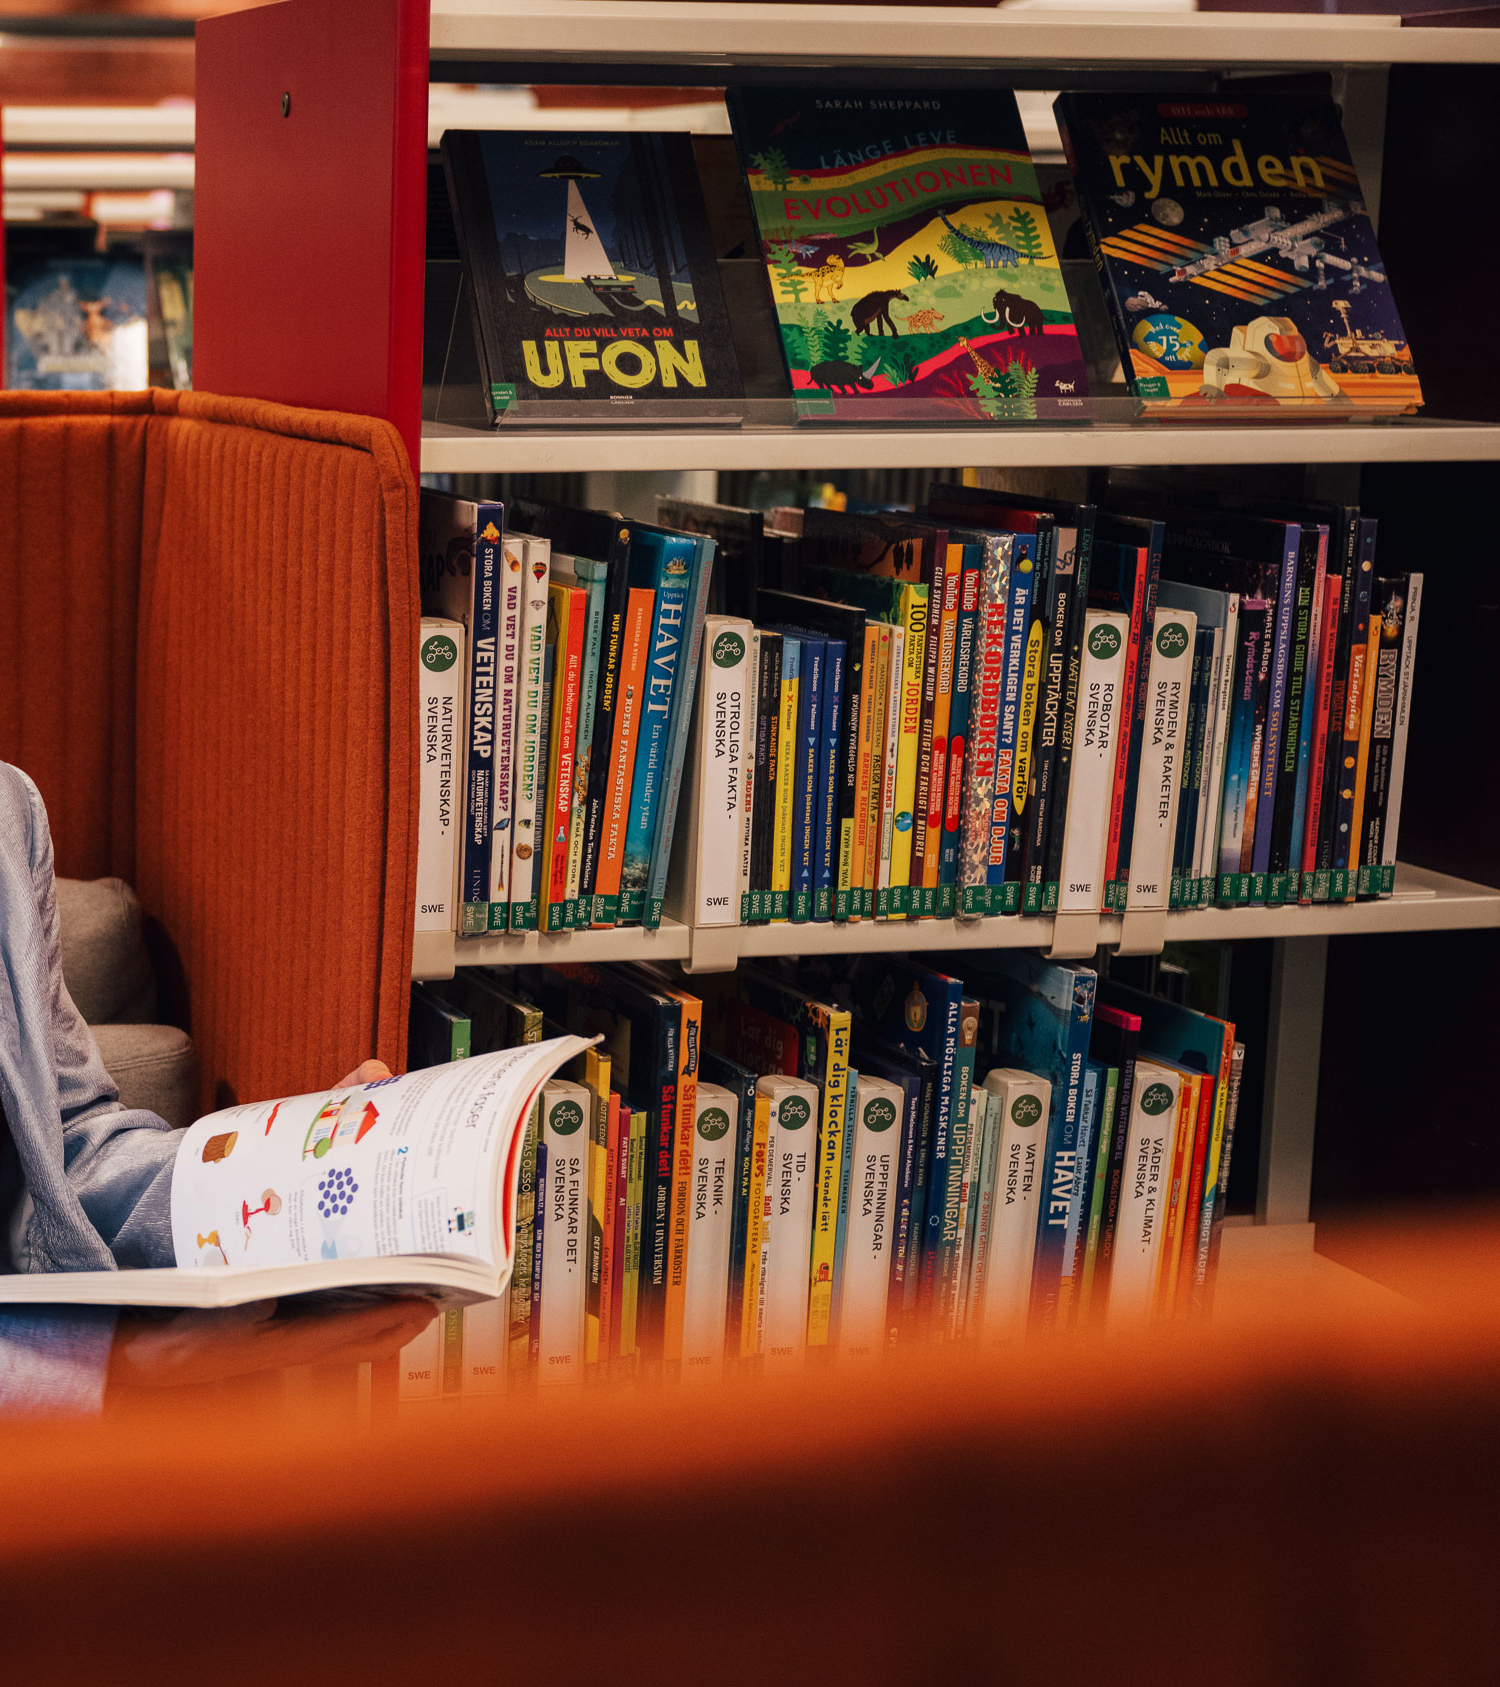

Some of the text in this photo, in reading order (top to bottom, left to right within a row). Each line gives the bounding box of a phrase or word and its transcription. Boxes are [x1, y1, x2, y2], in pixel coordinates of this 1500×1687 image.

[815, 100, 940, 110] SARAH SHEPPARD
[1161, 127, 1223, 145] Allt om
[820, 130, 957, 169] LÄNGE LEVE
[1109, 139, 1324, 199] rymden
[784, 164, 1014, 220] EVOLUTIONEN
[545, 328, 673, 337] ALLT DU VILL VETA OM
[1159, 336, 1180, 350] 75
[522, 340, 707, 388] UFON
[910, 603, 926, 632] 100
[939, 574, 959, 694] YouTube VÄRLDSREKORD
[473, 548, 495, 758] STORA BOKEN OM VETENSKAP
[602, 614, 620, 711] HUR FUNKAR JORDEN?
[908, 635, 916, 667] FAKTA OM
[914, 635, 923, 679] FANTASTISKA
[1042, 593, 1066, 747] BOKEN OM UPPTÄCKTER
[1243, 631, 1260, 700] Rymdstenen
[1264, 552, 1295, 797] BARNENS UPPSLAGSBOK OM SOLSYSTEMET
[1284, 587, 1311, 772] MIN STORA GUIDE TILL STJÄRNHIMLEN
[499, 586, 517, 811] VAD VET DU OM NATURVETENSKAP?
[640, 600, 683, 829] HAVET En värld under ytan
[904, 681, 920, 734] JORDEN
[975, 603, 1005, 777] REKORDBOKEN
[1016, 640, 1039, 800] Stora boken om varför
[1084, 683, 1100, 747] SVENSKA
[1098, 684, 1114, 748] ROBOTAR
[1153, 681, 1167, 745] SVENSKA
[1348, 655, 1363, 729] Vårt solsystem
[1374, 649, 1398, 738] RYMDEN
[427, 697, 437, 763] SVENSKA
[558, 654, 578, 812] Allt du behöver veta om VETENSKAP
[715, 692, 726, 758] SVENSKA
[727, 692, 741, 811] OTROLIGA FAKTA
[922, 719, 932, 751] GIFTIGT
[989, 588, 1028, 866] ÄR DET VERKLIGEN SANT? FAKTA OM DJUR
[1158, 682, 1180, 819] RYMDEN & RAKETER
[440, 697, 452, 827] NATURVETENSKAP
[612, 740, 628, 820] FANTASTISKA
[918, 776, 928, 810] FARLIGT
[920, 754, 930, 772] OCH
[474, 770, 484, 844] NATURVETENSKAP
[825, 795, 834, 825] (nästan)
[607, 823, 618, 860] FAKTA
[915, 820, 926, 857] NATUREN
[421, 904, 444, 913] SWE
[515, 906, 523, 925] SWE
[707, 897, 729, 906] SWE
[924, 890, 932, 910] SWE
[1070, 884, 1091, 892] SWE
[1136, 885, 1157, 893] SWE
[1255, 877, 1263, 896] SWE
[936, 1002, 958, 1159] ALLA MÖJLIGA MASKINER
[820, 1027, 847, 1232] Lär dig klockan lekande lätt
[942, 1067, 969, 1241] BOKEN OM UPPFINNINGAR
[1049, 1053, 1081, 1228] STORA BOKEN OM HAVET
[554, 1159, 565, 1221] SVENSKA
[672, 1084, 695, 1286] Så funkar det! FORDON OCH FARKOSTER
[696, 1158, 709, 1220] SVENSKA
[713, 1159, 725, 1206] TEKNIK
[780, 1153, 792, 1215] SVENSKA
[796, 1152, 806, 1173] TID
[862, 1155, 876, 1216] SVENSKA
[1005, 1144, 1021, 1205] SVENSKA
[1023, 1144, 1036, 1192] VATTEN
[1134, 1138, 1150, 1199] SVENSKA
[1141, 1138, 1164, 1244] VÄDER & KLIMAT
[567, 1158, 580, 1264] SÅ FUNKAR DET
[656, 1185, 667, 1219] JORDEN
[872, 1155, 890, 1251] UPPFINNINGAR
[1202, 1201, 1213, 1242] VIRRIGT
[652, 1230, 664, 1284] UNIVERSUM
[549, 1356, 570, 1364] SWE
